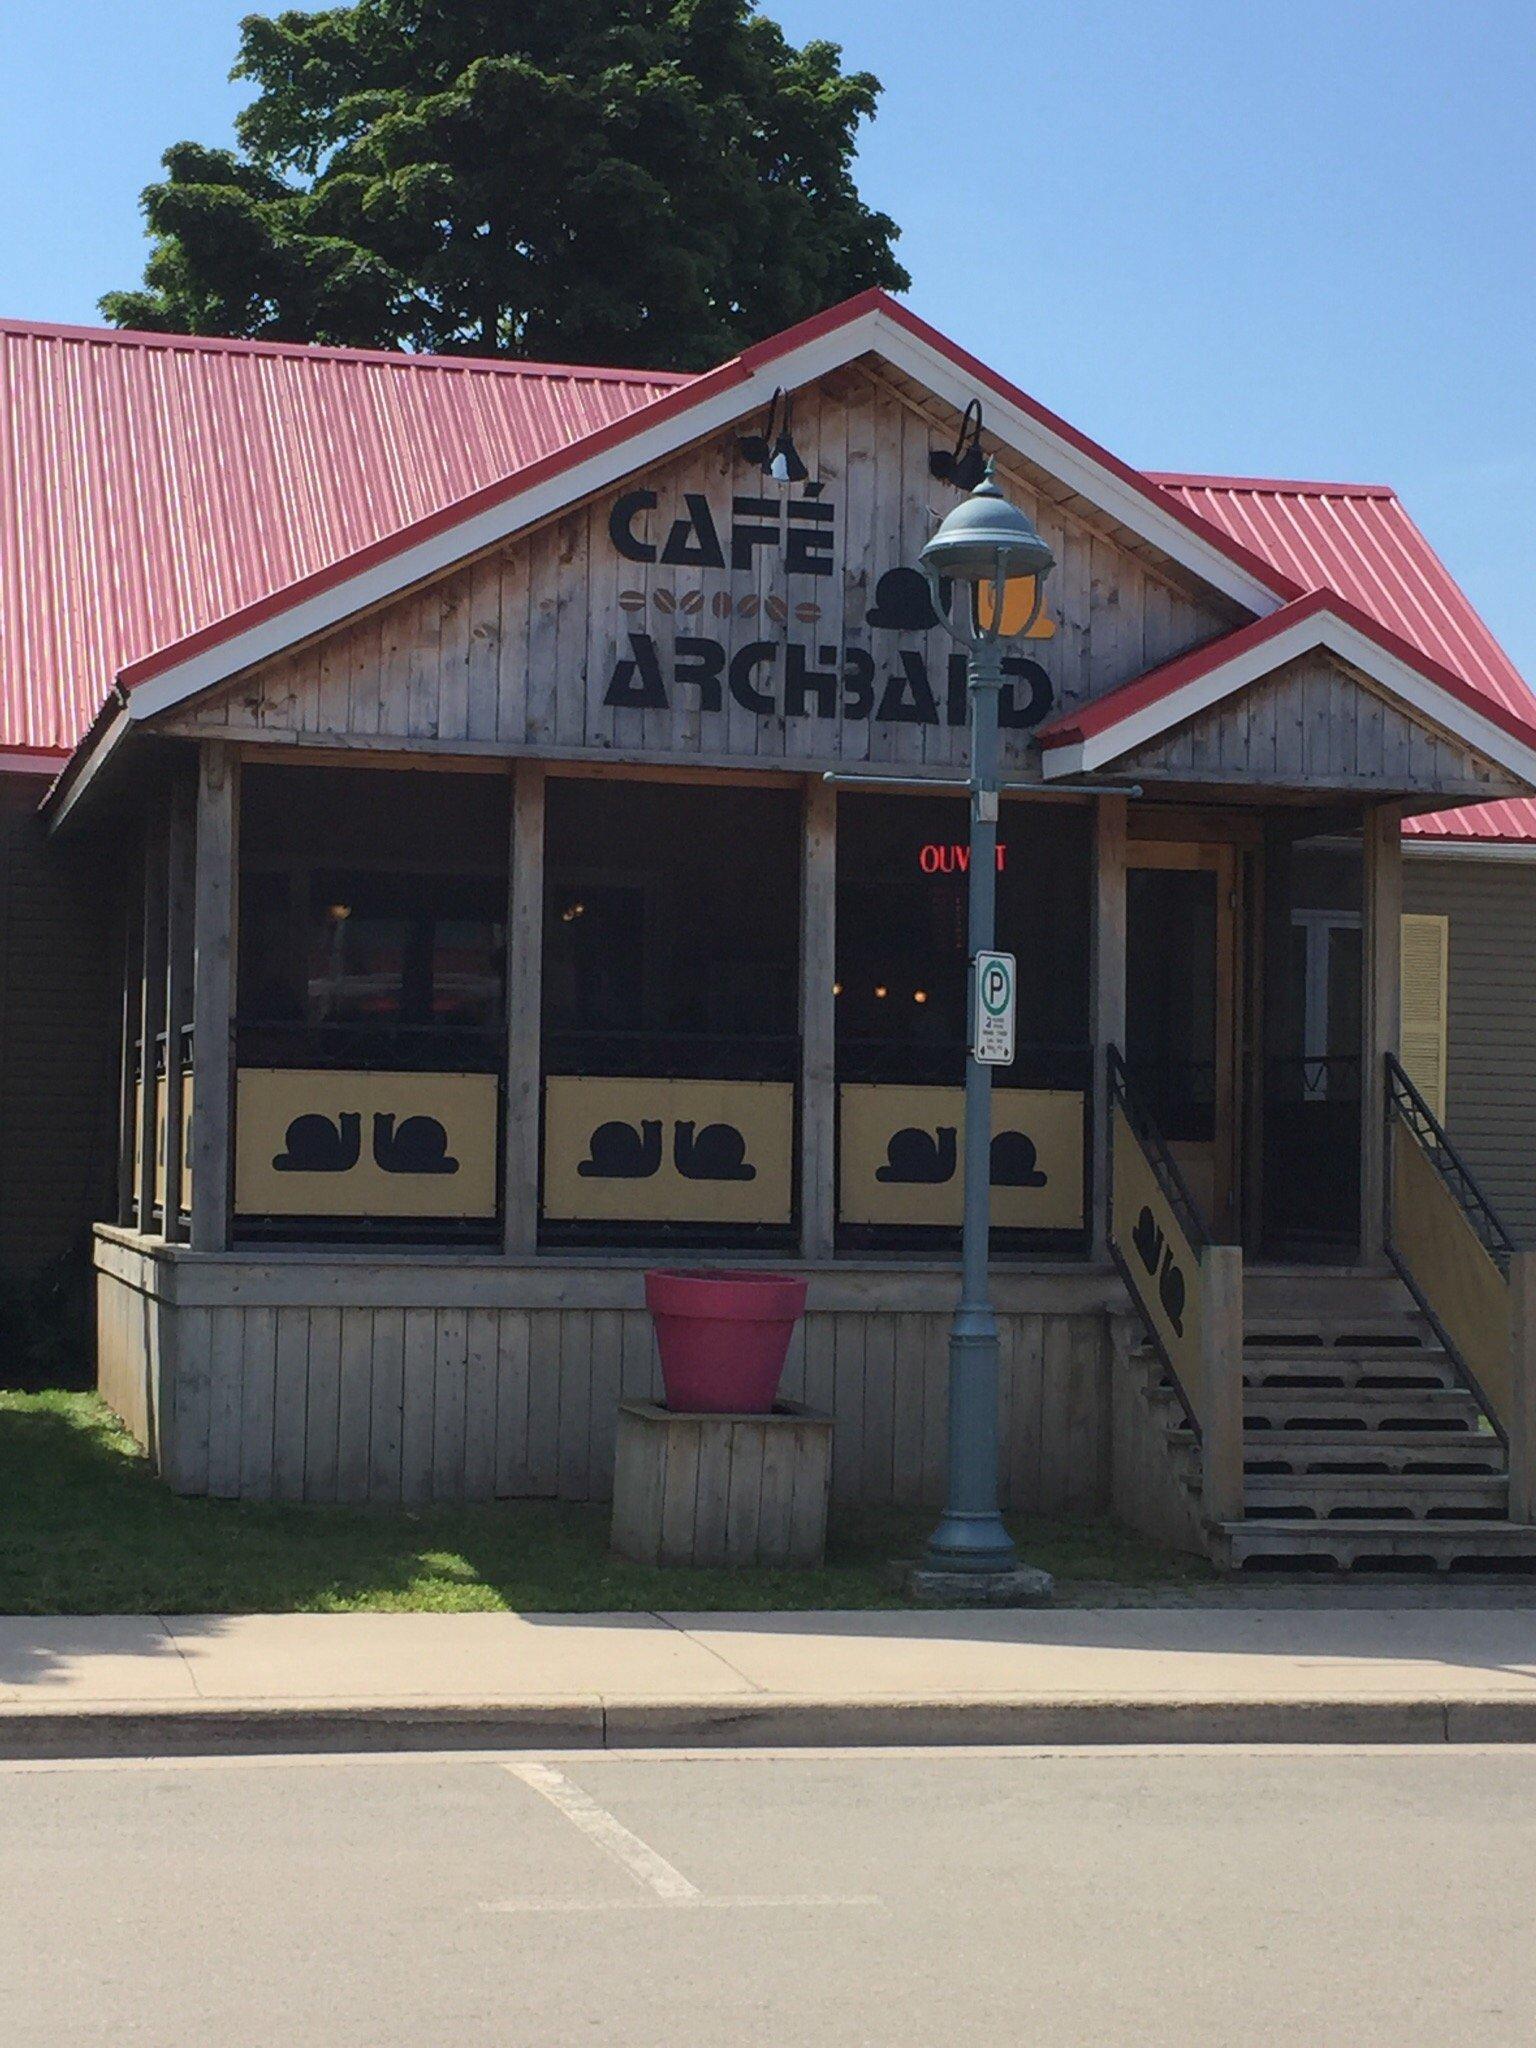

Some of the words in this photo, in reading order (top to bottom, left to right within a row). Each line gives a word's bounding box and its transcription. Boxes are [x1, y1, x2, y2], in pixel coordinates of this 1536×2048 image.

[609, 481, 835, 576] CAFÉ
[919, 844, 1007, 873] OUVT
[990, 971, 1004, 1004] P
